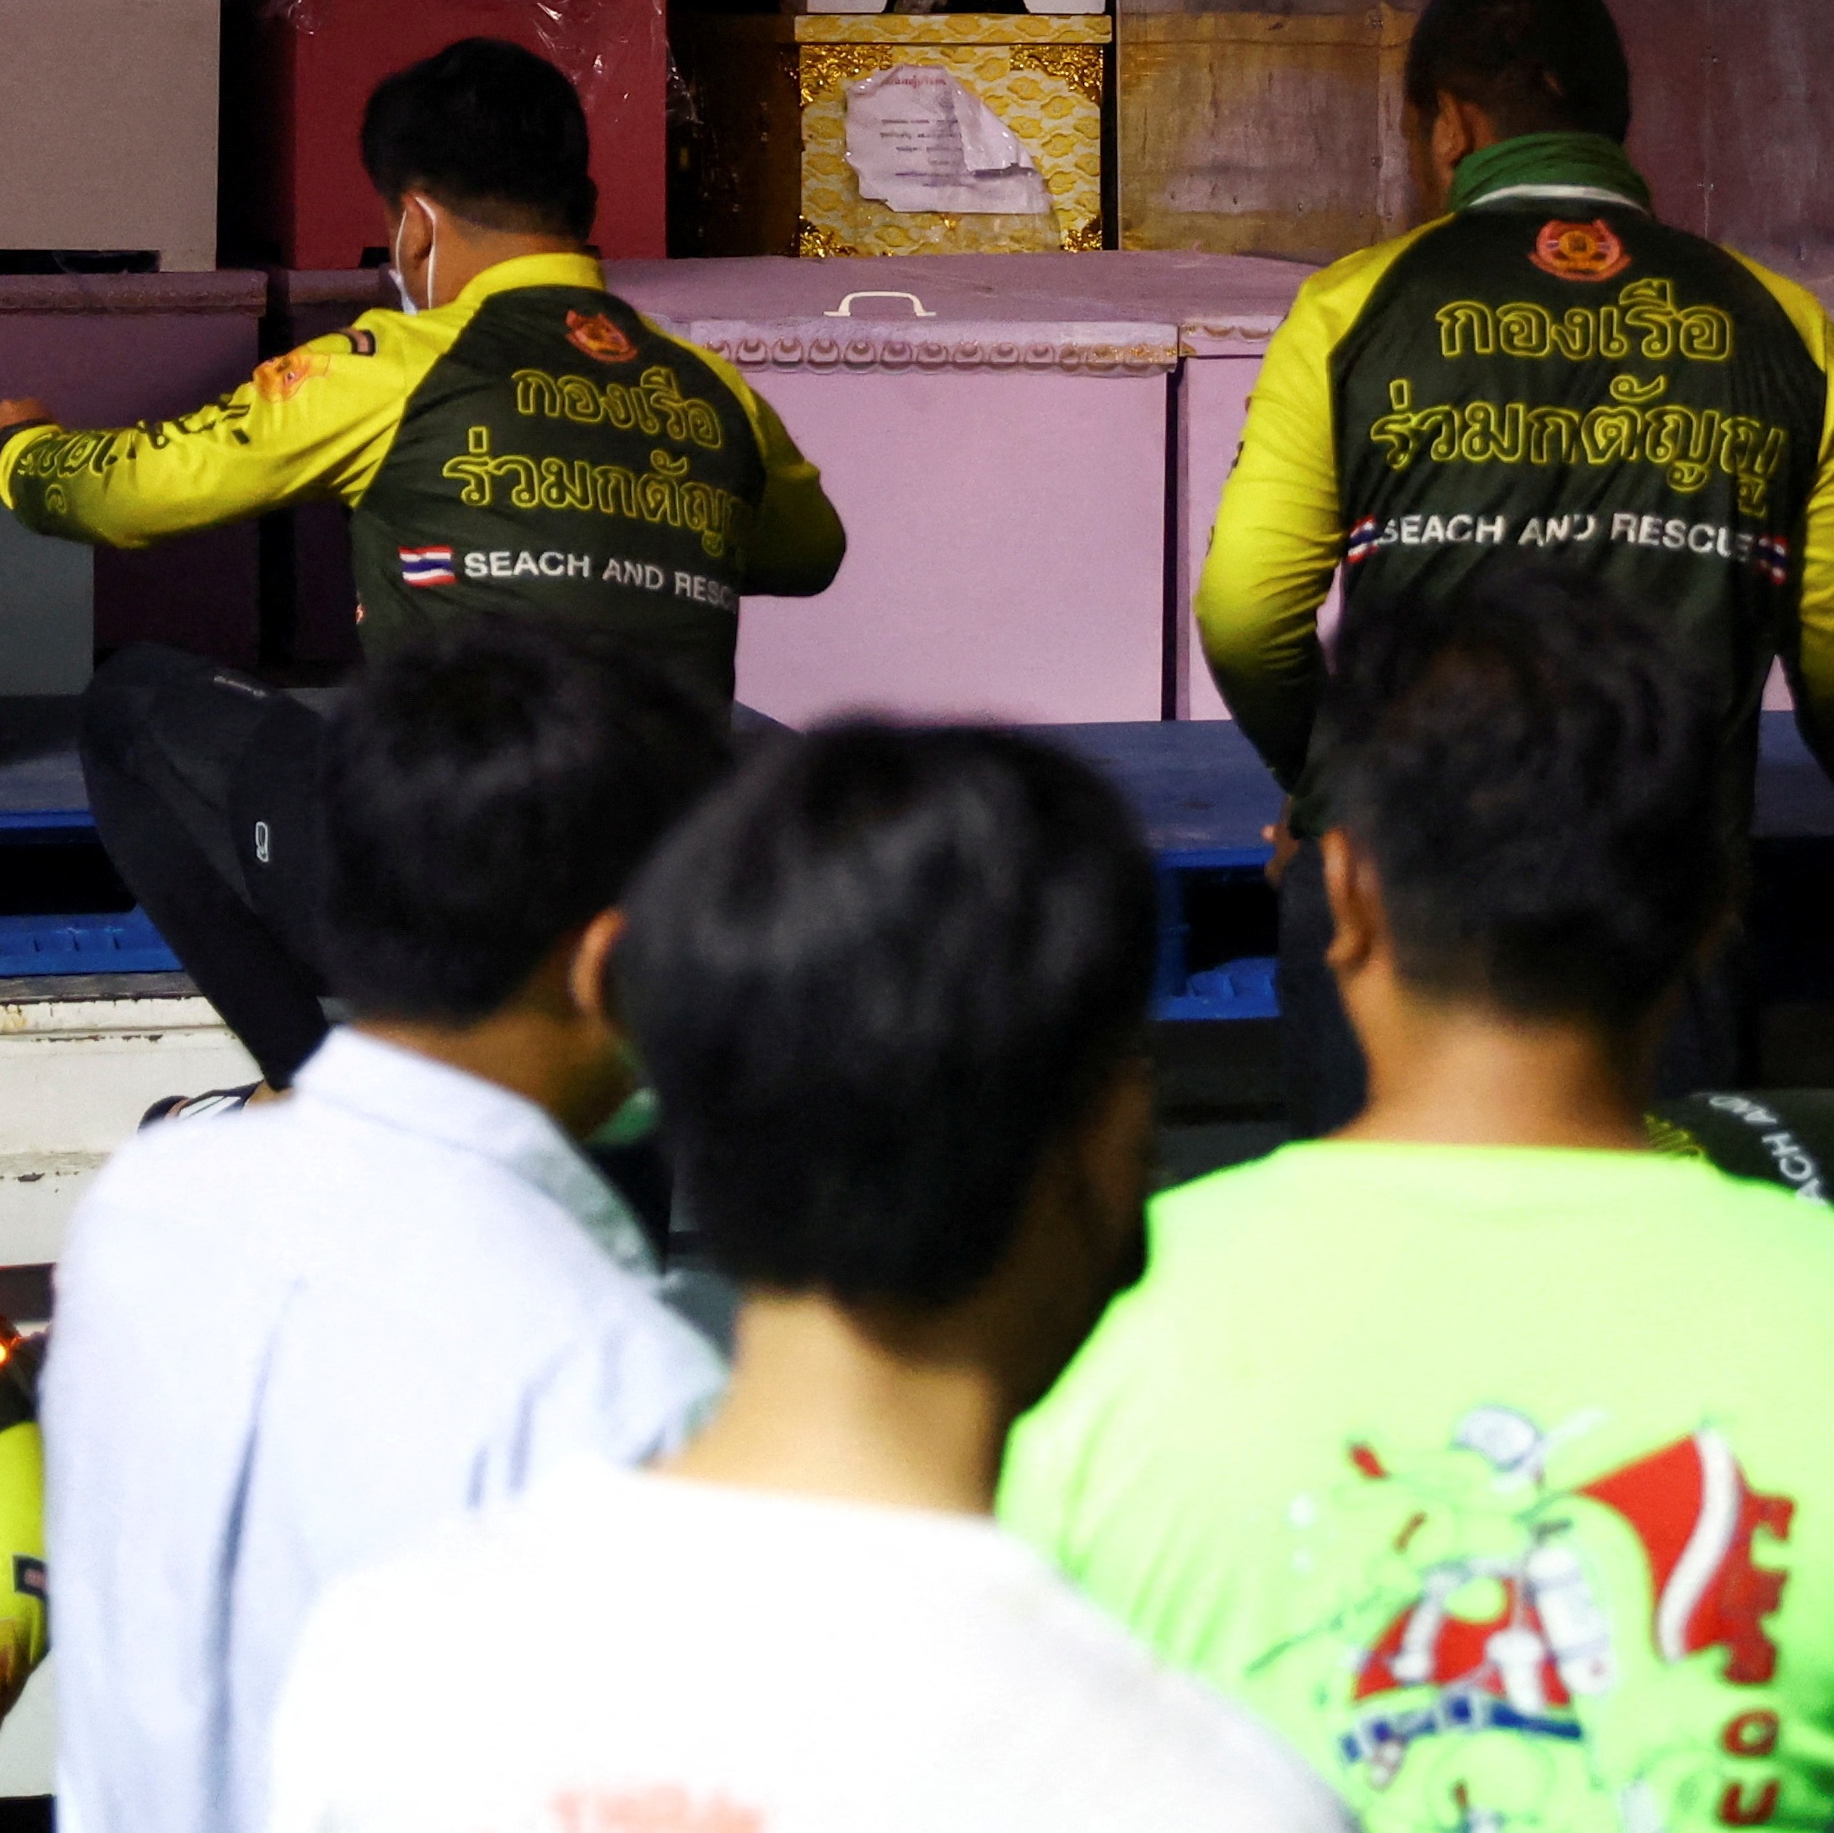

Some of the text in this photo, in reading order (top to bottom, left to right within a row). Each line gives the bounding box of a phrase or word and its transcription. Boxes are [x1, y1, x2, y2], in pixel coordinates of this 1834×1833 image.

[1435, 277, 1734, 360] กองเรือ
[511, 366, 721, 449] กองเรือ
[442, 426, 739, 557] ร่วมกตัญ
[463, 550, 738, 613] SEACH AND RESC
